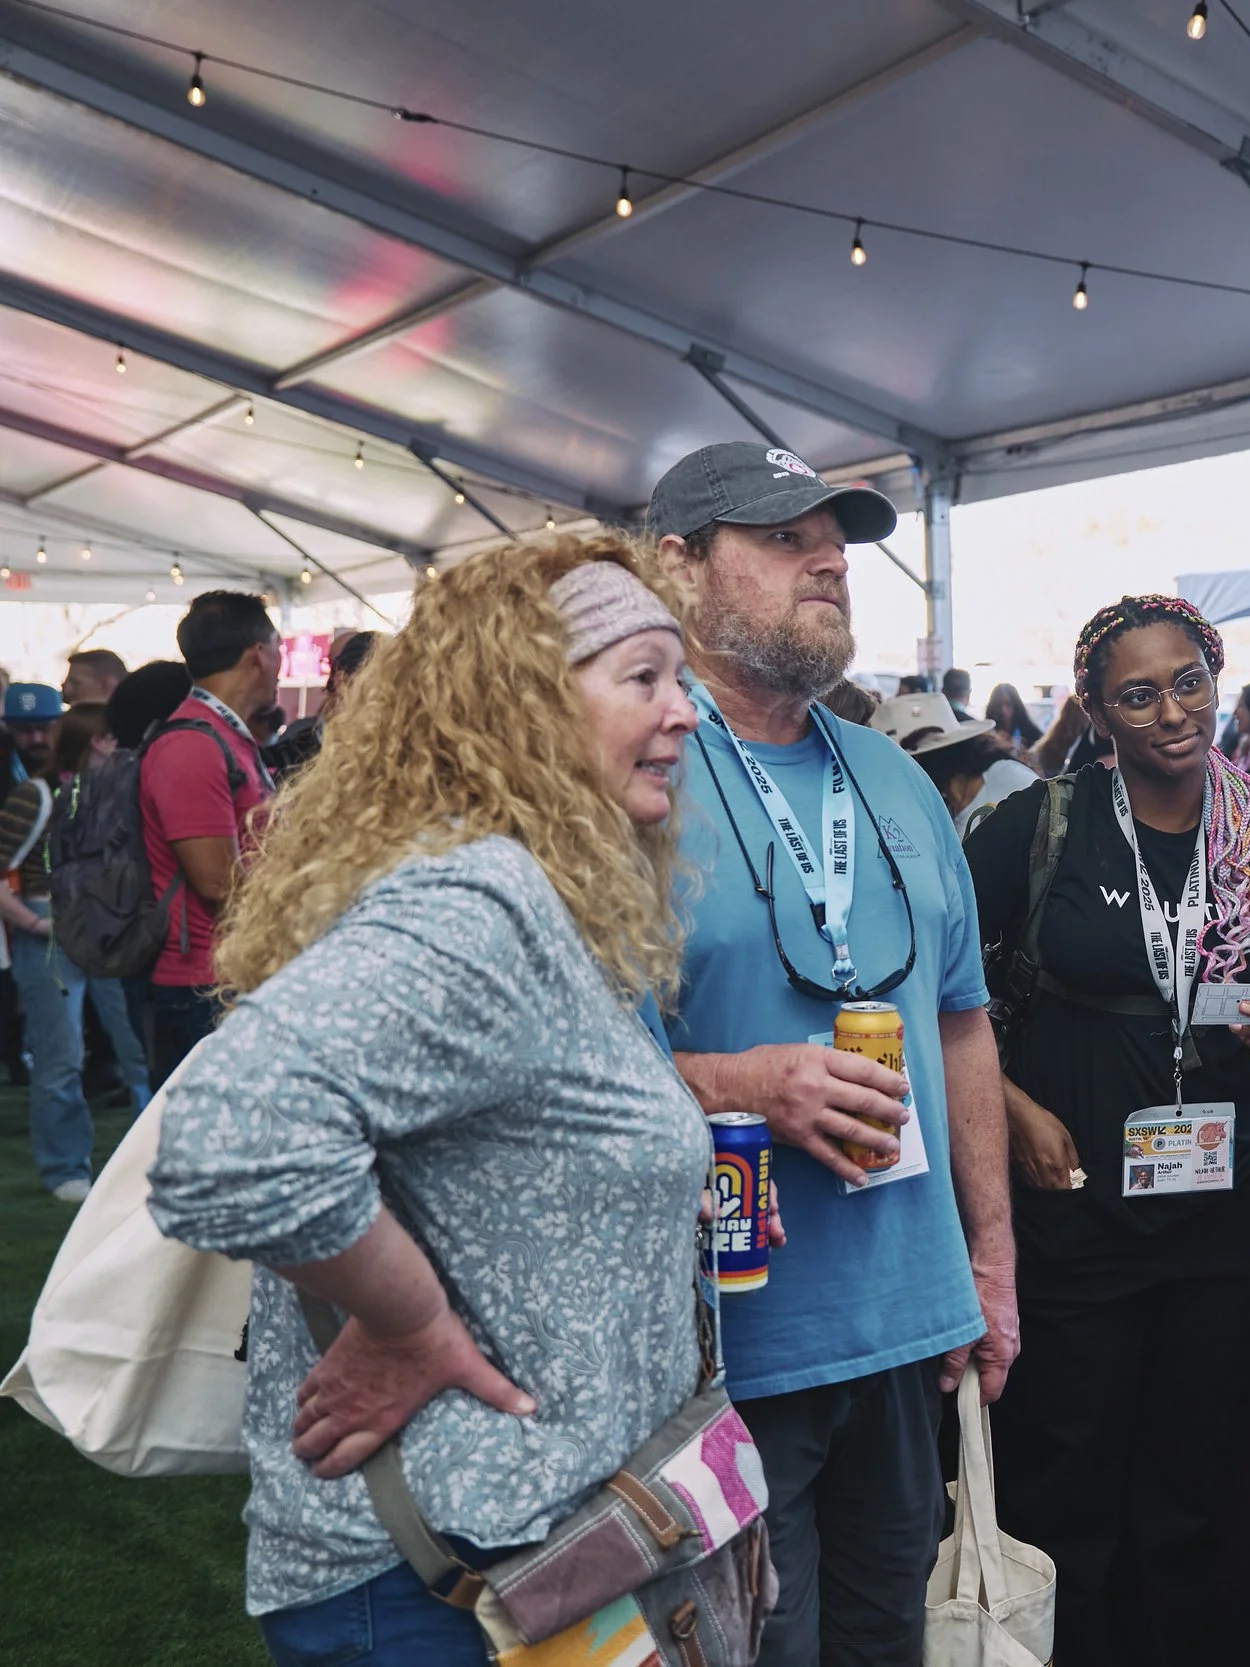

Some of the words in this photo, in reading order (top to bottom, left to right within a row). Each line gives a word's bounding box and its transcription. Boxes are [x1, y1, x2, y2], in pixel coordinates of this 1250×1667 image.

[746, 756, 772, 794] 2025
[1113, 783, 1122, 800] LAST
[1116, 797, 1125, 808] OF
[1119, 805, 1128, 817] US
[777, 817, 793, 832] THE
[832, 819, 846, 829] US
[833, 829, 847, 838] OF
[882, 825, 904, 842] K2
[784, 831, 804, 851] LAST
[833, 839, 847, 859] LAST
[888, 844, 914, 852] viation
[794, 851, 809, 861] OF
[799, 861, 815, 873] US
[833, 860, 846, 874] THE
[1141, 880, 1155, 911] 2025
[1150, 931, 1162, 943] THE
[1185, 928, 1197, 938] US
[1185, 938, 1196, 946] OF
[1151, 943, 1166, 960] LAST
[1184, 947, 1196, 964] LAST
[1155, 961, 1168, 969] OF
[1184, 964, 1194, 977] THE
[1157, 969, 1169, 979] US
[1128, 1126, 1157, 1137] SXSW
[1157, 1162, 1183, 1171] Najah
[758, 1149, 769, 1211] HAZY
[756, 1212, 768, 1249] IPA
